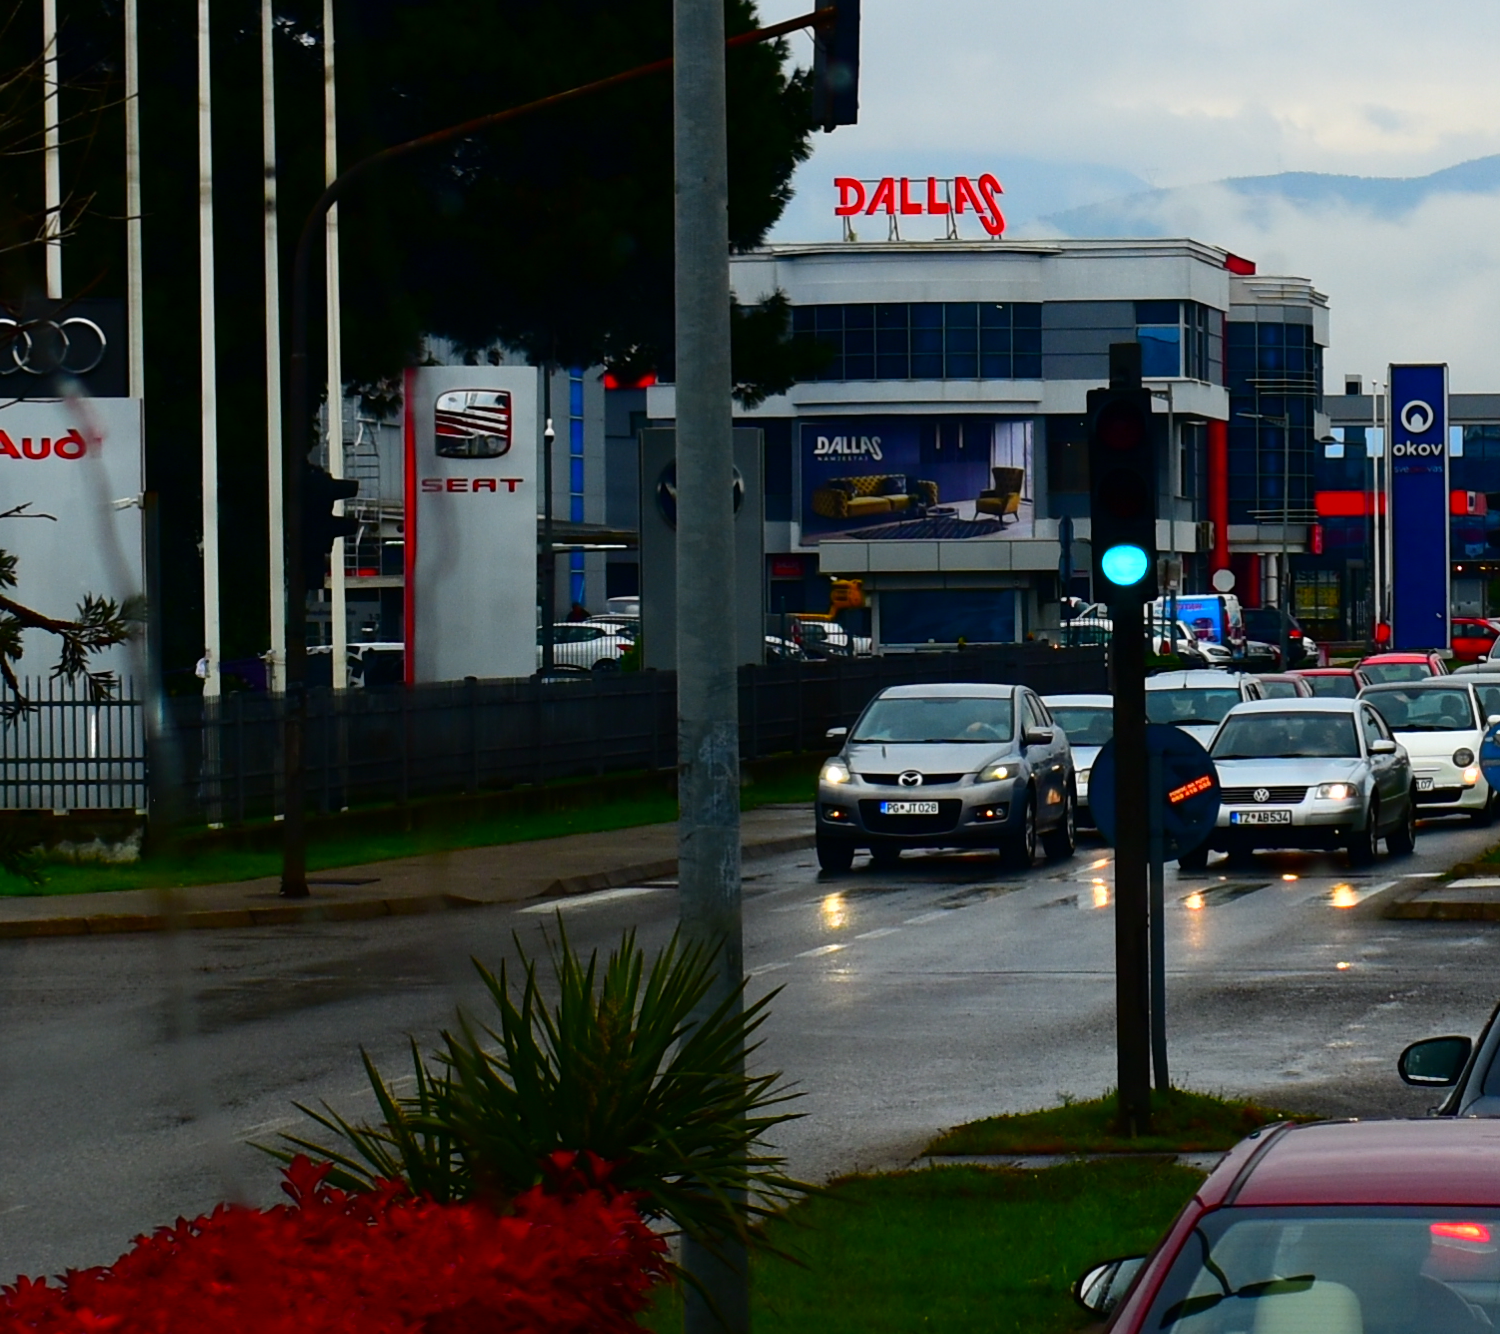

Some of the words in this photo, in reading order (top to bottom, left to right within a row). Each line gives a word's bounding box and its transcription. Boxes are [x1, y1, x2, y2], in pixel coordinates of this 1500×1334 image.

[834, 174, 1006, 235] DALLAS
[813, 436, 883, 461] DALLAS
[1392, 440, 1442, 456] okov
[421, 478, 524, 493] SEAT
[887, 803, 899, 813] PG
[1238, 813, 1250, 823] TZ
